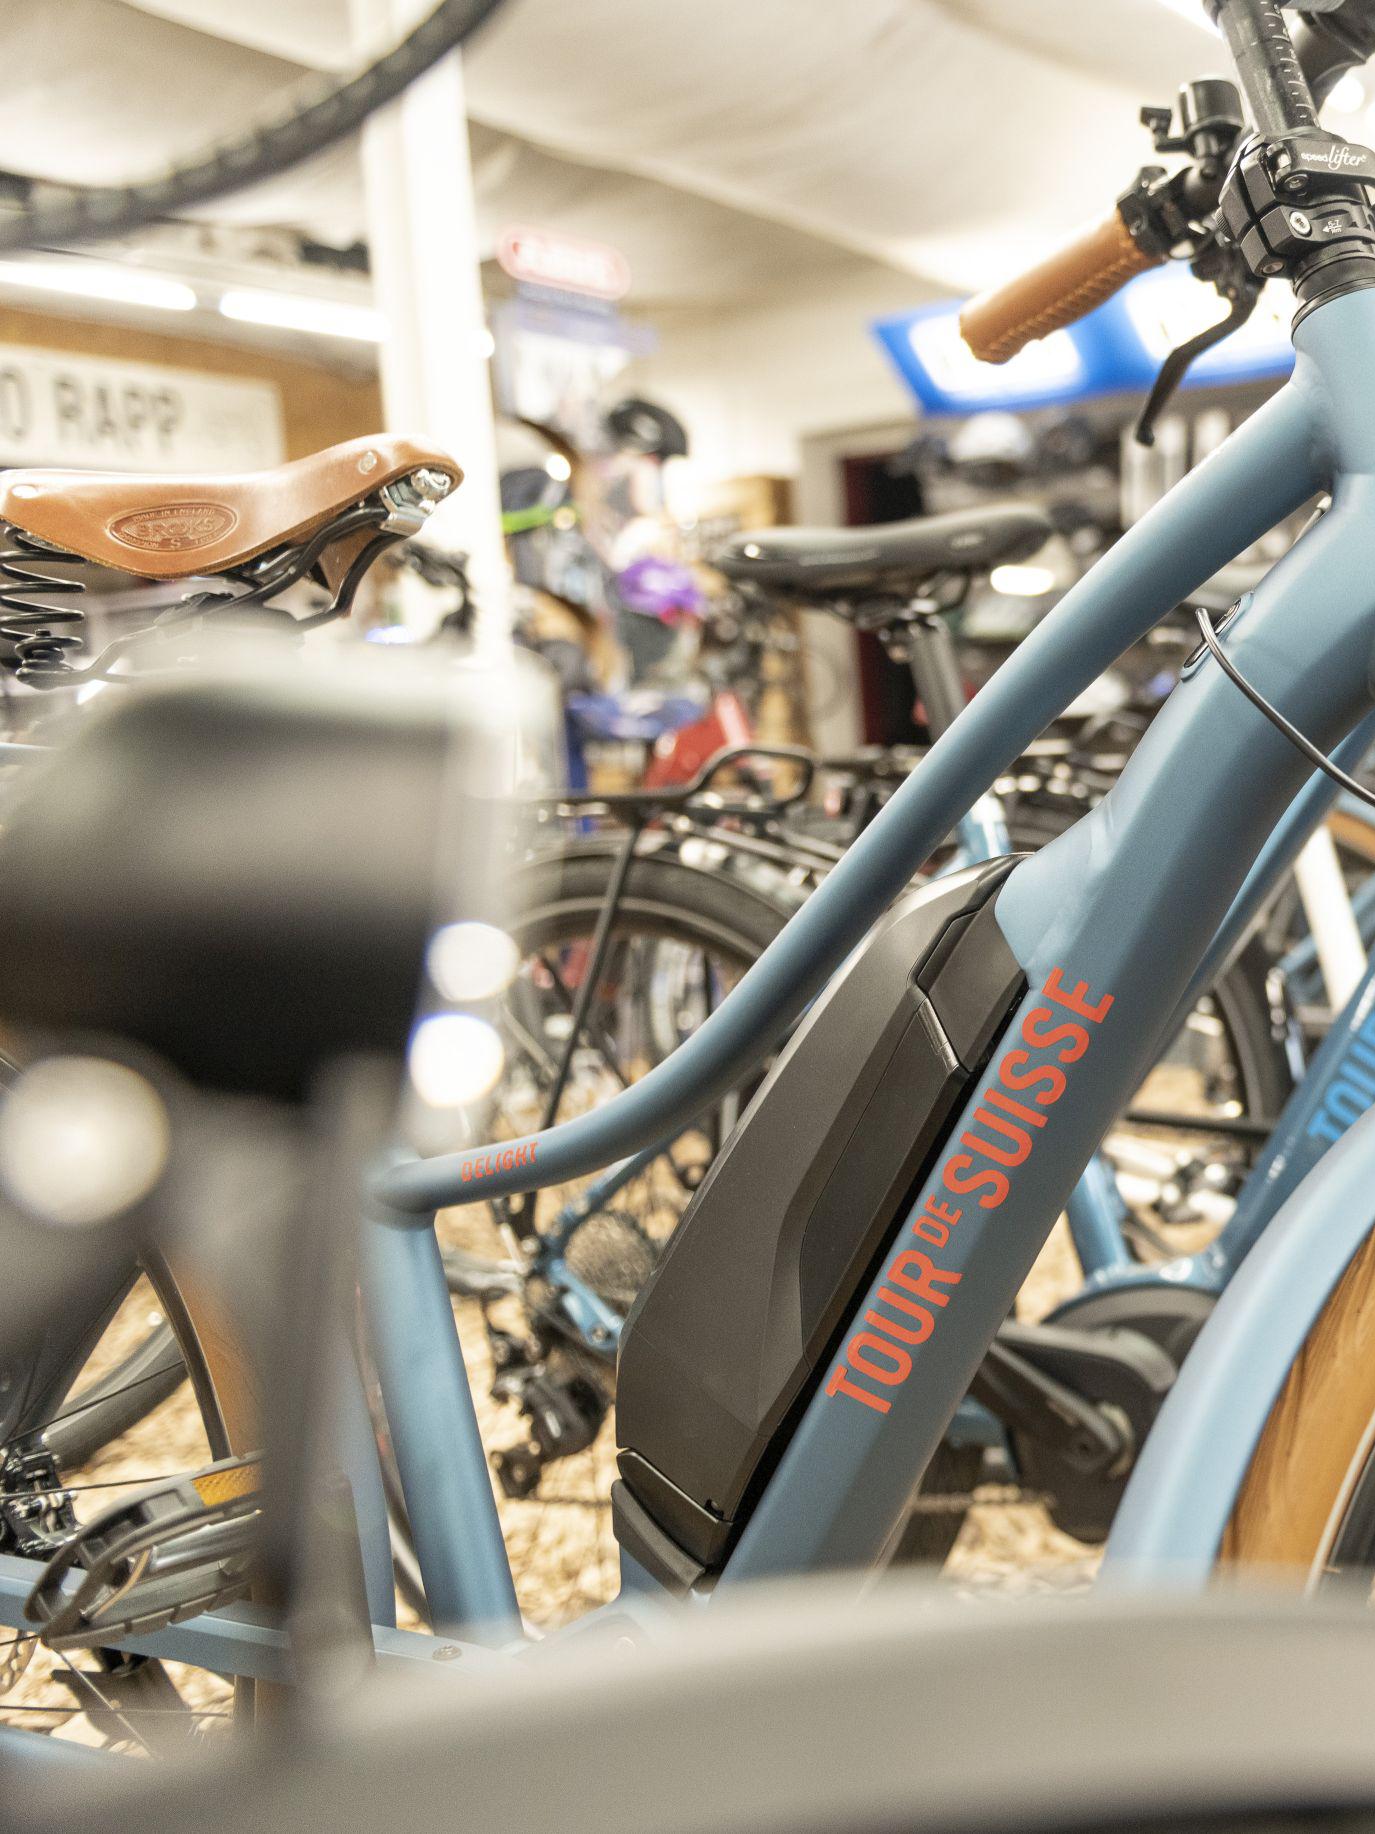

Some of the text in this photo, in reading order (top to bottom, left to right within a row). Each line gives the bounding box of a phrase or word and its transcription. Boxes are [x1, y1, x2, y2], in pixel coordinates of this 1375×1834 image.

[53, 374, 185, 456] RAPP
[461, 1141, 538, 1183] DELIGHT
[824, 967, 1115, 1414] TOUR DE SUISSE
